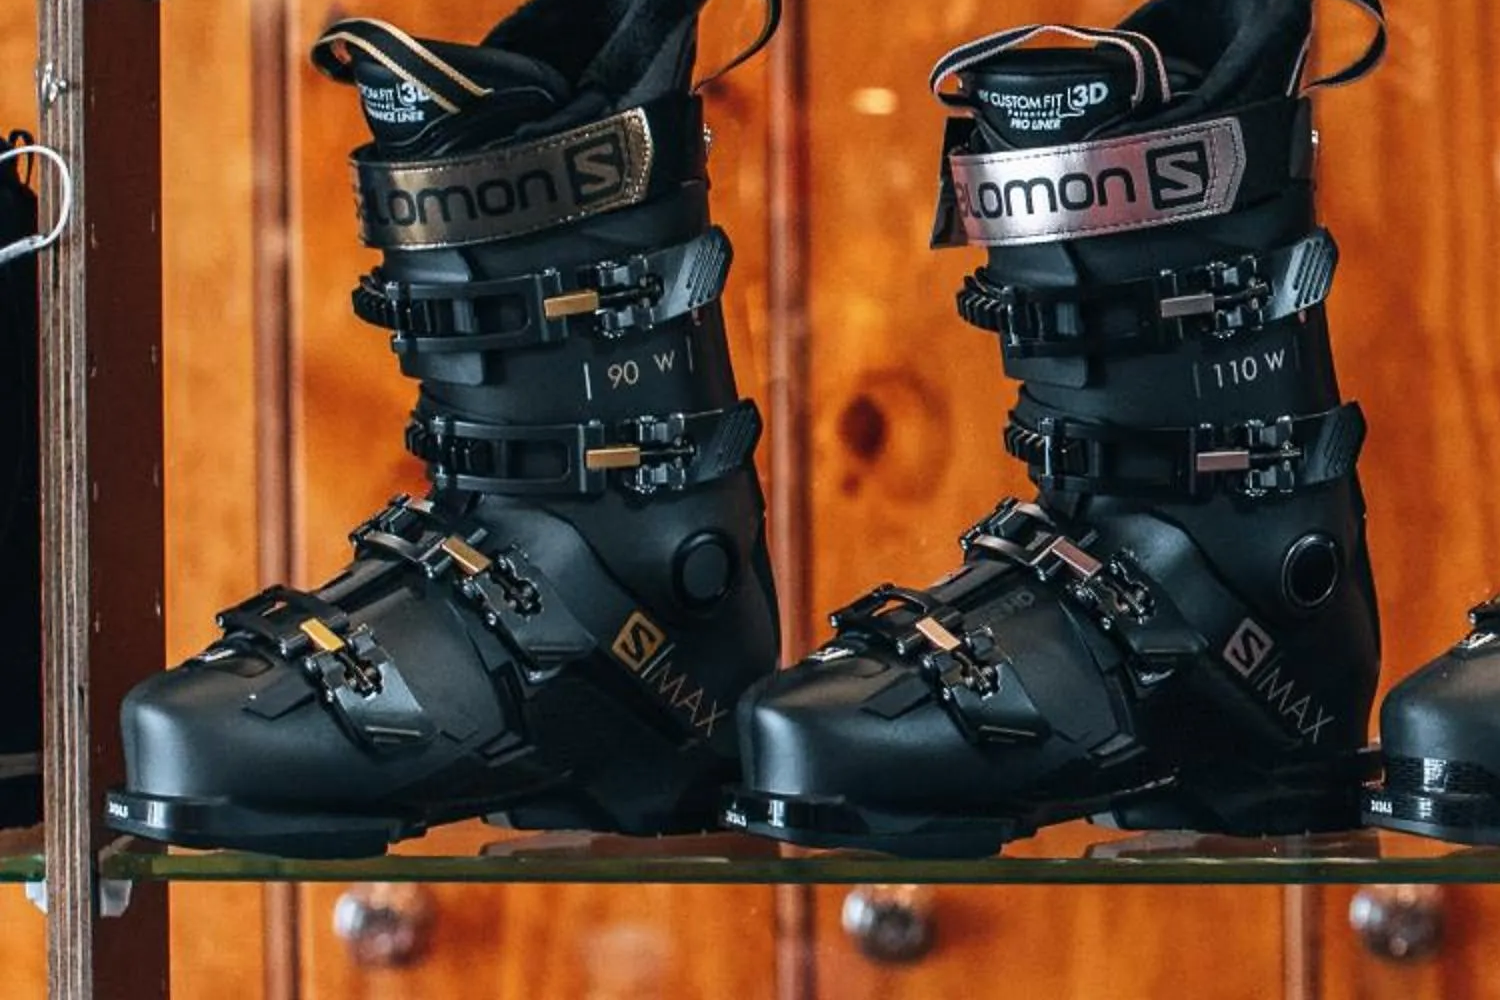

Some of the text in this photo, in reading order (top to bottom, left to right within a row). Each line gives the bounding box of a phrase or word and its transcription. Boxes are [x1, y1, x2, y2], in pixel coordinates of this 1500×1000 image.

[990, 92, 1042, 109] CUSTOM
[1043, 93, 1065, 109] FIT
[1072, 81, 1109, 107] 3D
[1010, 118, 1062, 131] PRO LINER
[607, 349, 676, 390] 90 W
[1213, 347, 1286, 389] 110 W
[647, 661, 730, 738] MAX
[1256, 665, 1337, 745] MAX
